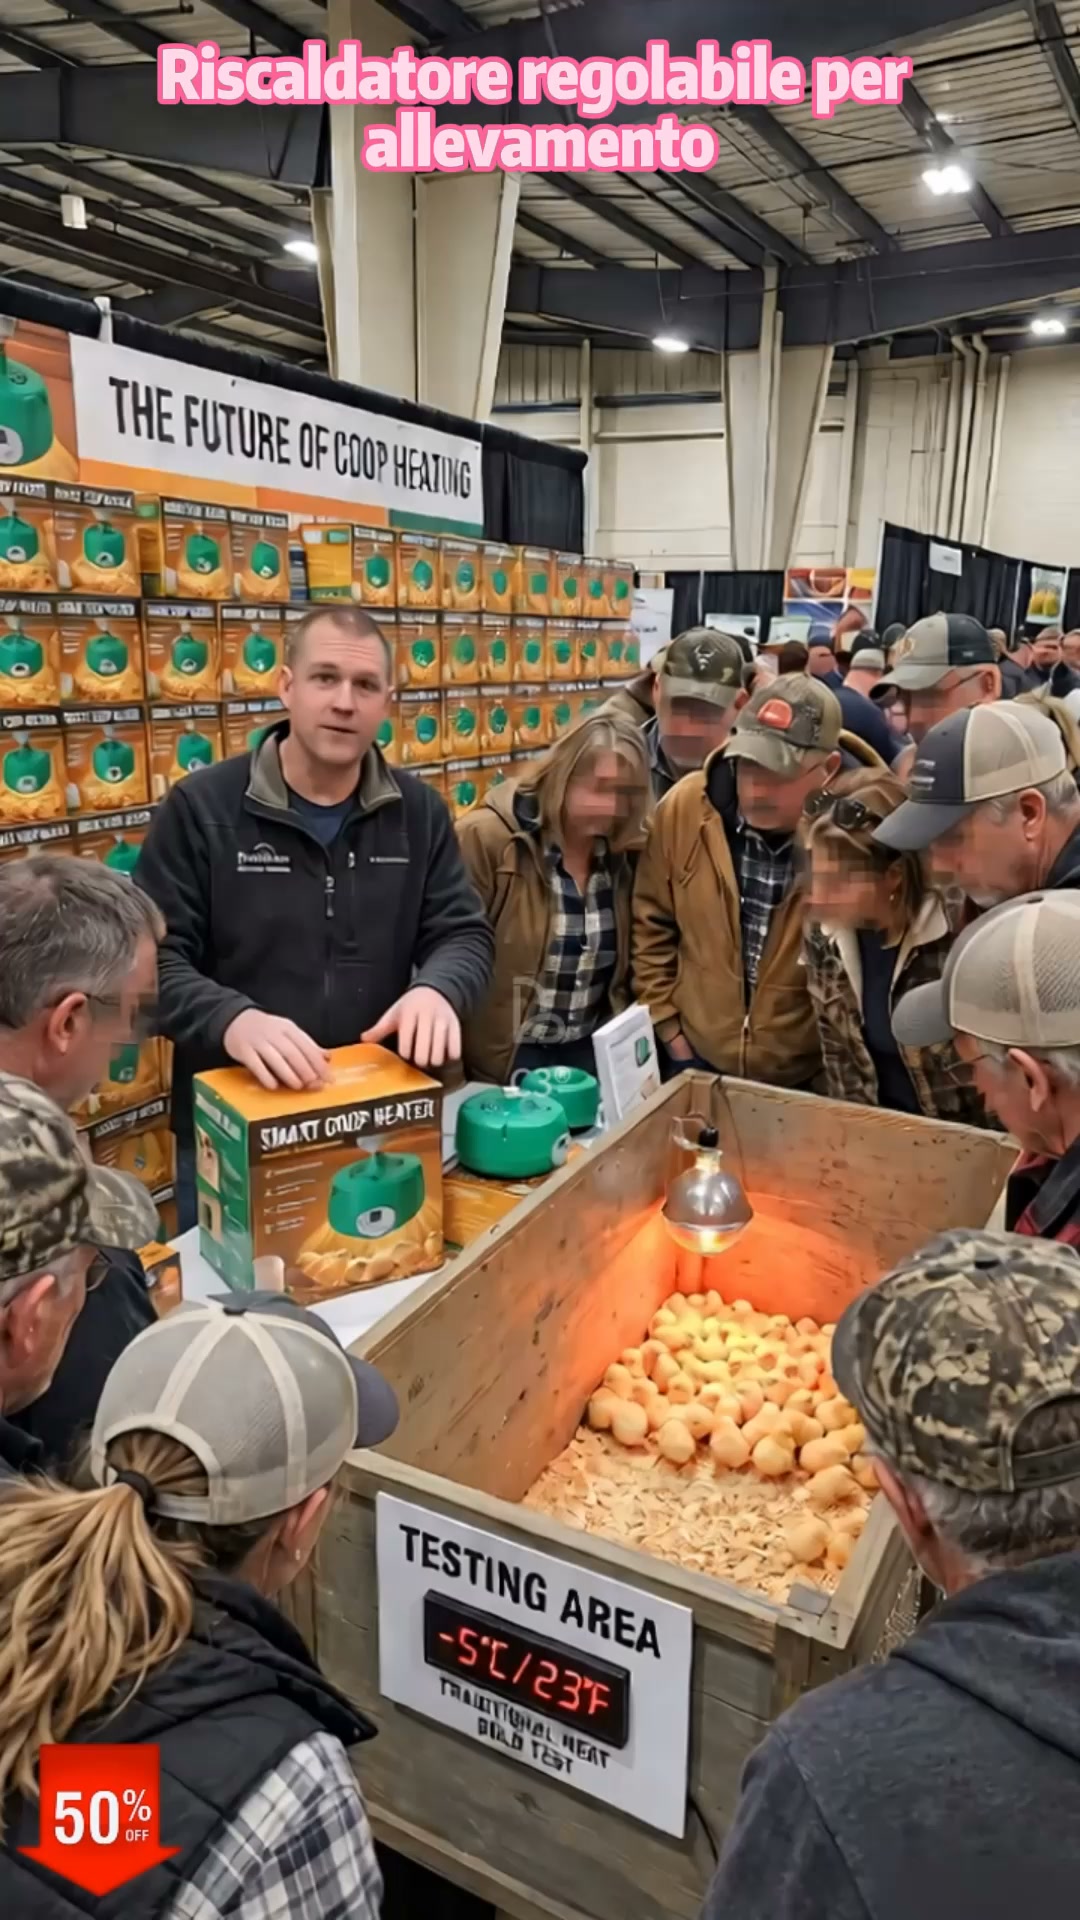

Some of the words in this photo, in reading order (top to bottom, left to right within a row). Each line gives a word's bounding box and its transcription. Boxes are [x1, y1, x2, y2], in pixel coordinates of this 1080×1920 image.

[109, 376, 175, 444] THE
[184, 395, 290, 465] FUTURE
[300, 422, 329, 471] OF
[334, 431, 388, 482] COOP
[399, 1524, 547, 1613] TESTING
[560, 1588, 661, 1659] AREA
